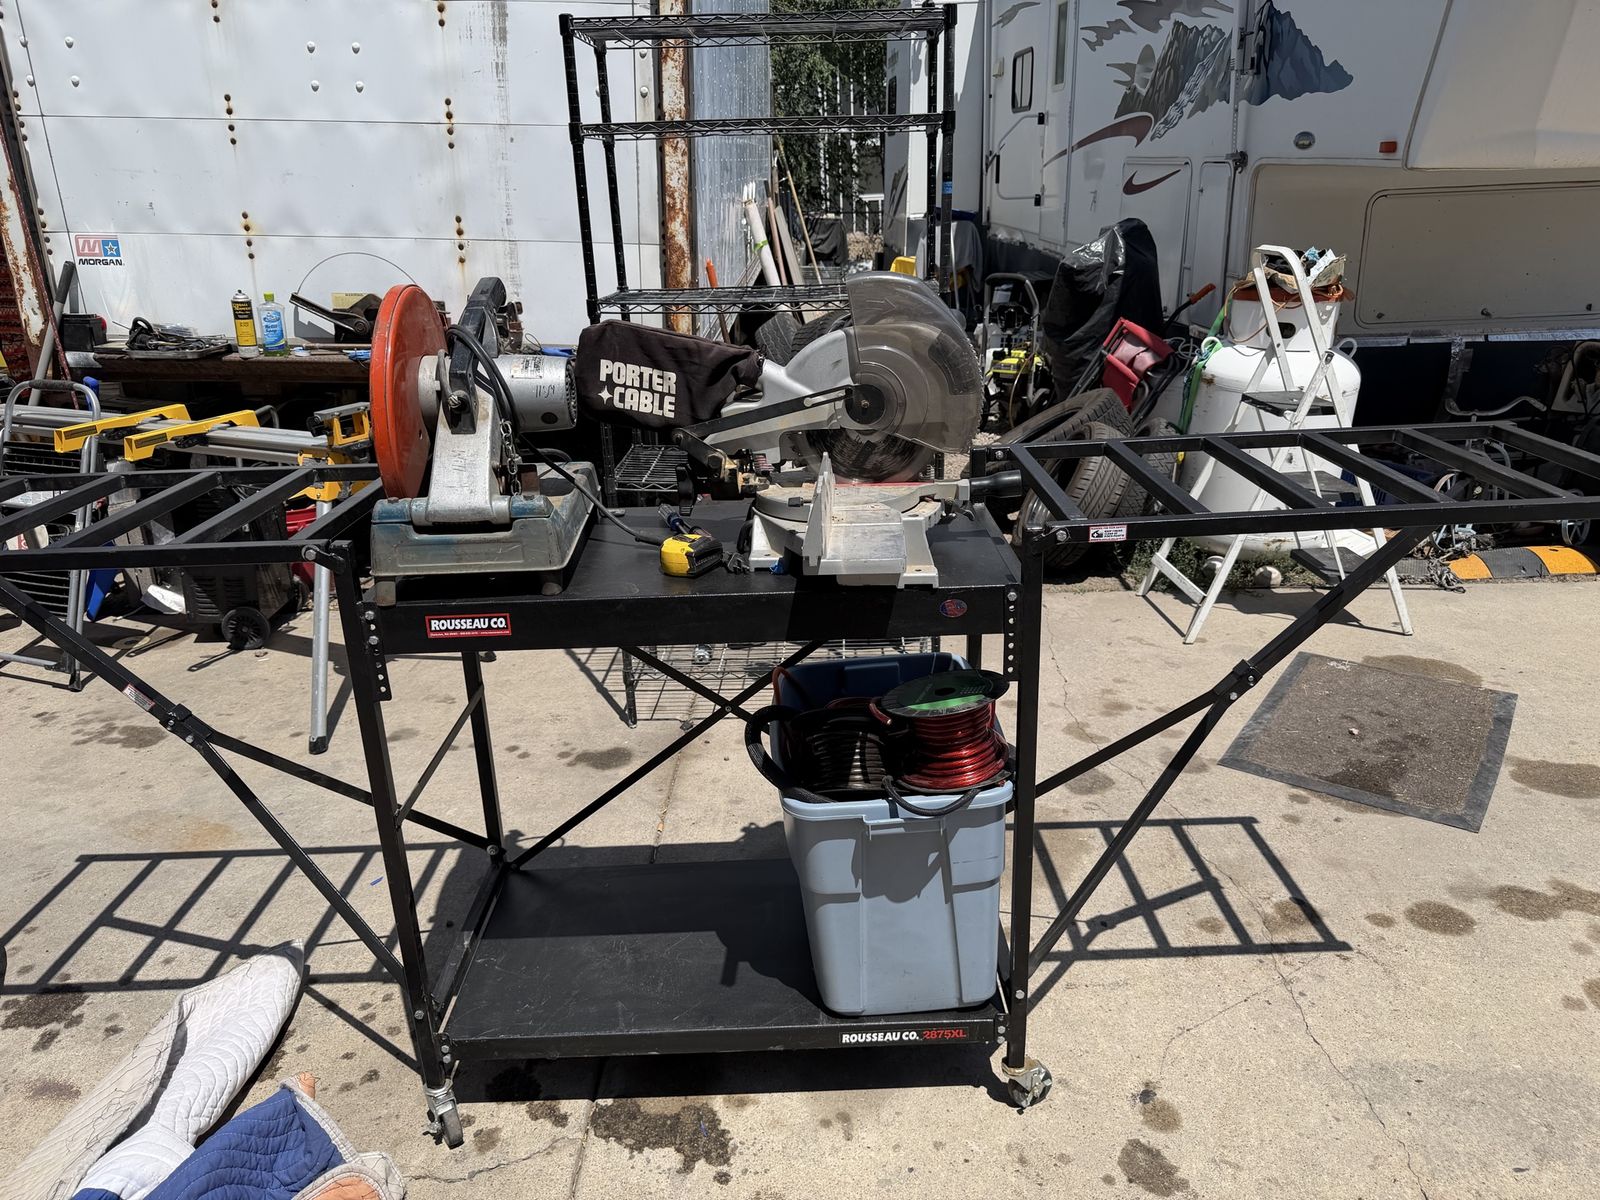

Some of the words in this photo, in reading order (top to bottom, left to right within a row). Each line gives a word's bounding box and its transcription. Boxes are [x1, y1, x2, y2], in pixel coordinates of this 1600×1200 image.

[78, 258, 123, 266] MORGAN
[600, 359, 677, 395] PORTER
[613, 386, 676, 418] CABLE
[430, 618, 489, 631] ROUSSEAU
[490, 617, 507, 628] CO.
[842, 1031, 901, 1043] ROUSSEAU
[902, 1031, 919, 1040] CO.
[922, 1029, 967, 1040] 2875XL
